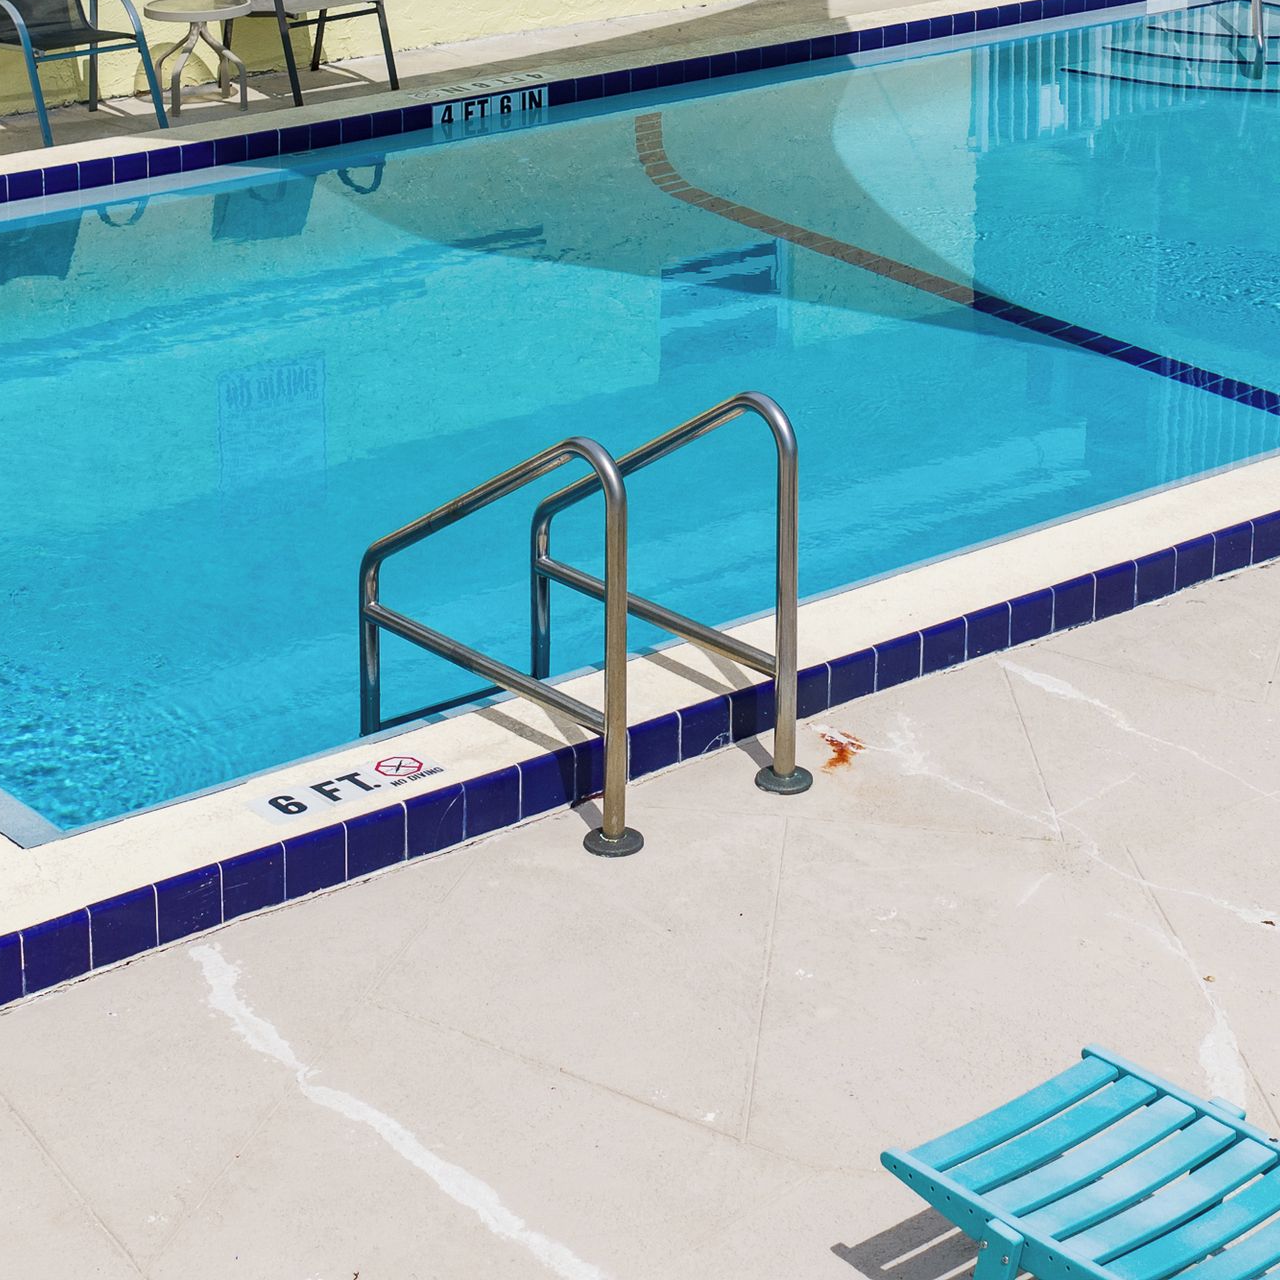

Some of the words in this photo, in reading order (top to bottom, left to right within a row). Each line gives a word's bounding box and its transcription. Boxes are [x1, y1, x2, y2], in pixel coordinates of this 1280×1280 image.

[441, 104, 454, 124] 4
[464, 98, 489, 121] FT
[500, 95, 512, 114] 6
[522, 89, 542, 111] IN
[267, 795, 308, 816] 6
[309, 772, 382, 802] FT.
[390, 778, 408, 788] NO
[410, 766, 444, 782] DIVING
